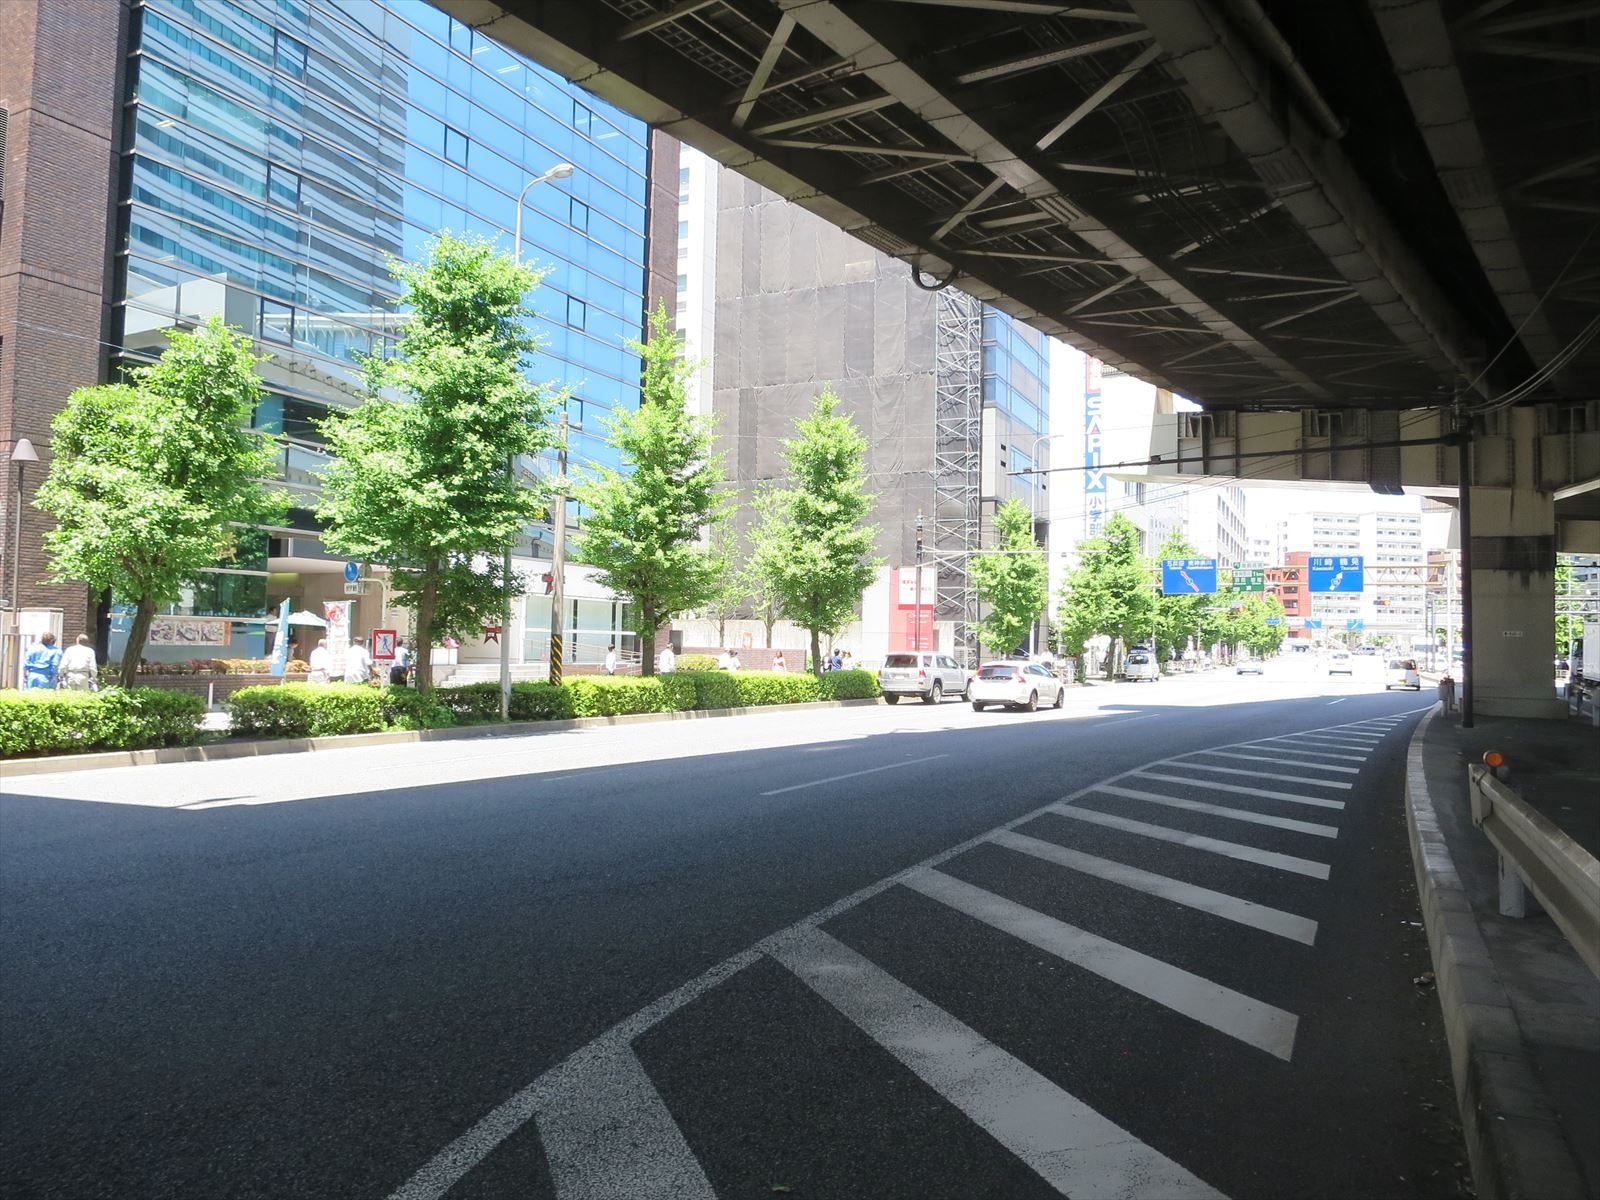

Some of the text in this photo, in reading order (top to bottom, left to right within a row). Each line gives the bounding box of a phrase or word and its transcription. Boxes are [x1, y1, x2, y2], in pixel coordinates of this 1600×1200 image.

[1086, 397, 1105, 489] SAPIX
[1089, 496, 1103, 536] 小学部
[1312, 558, 1333, 566] 川崎
